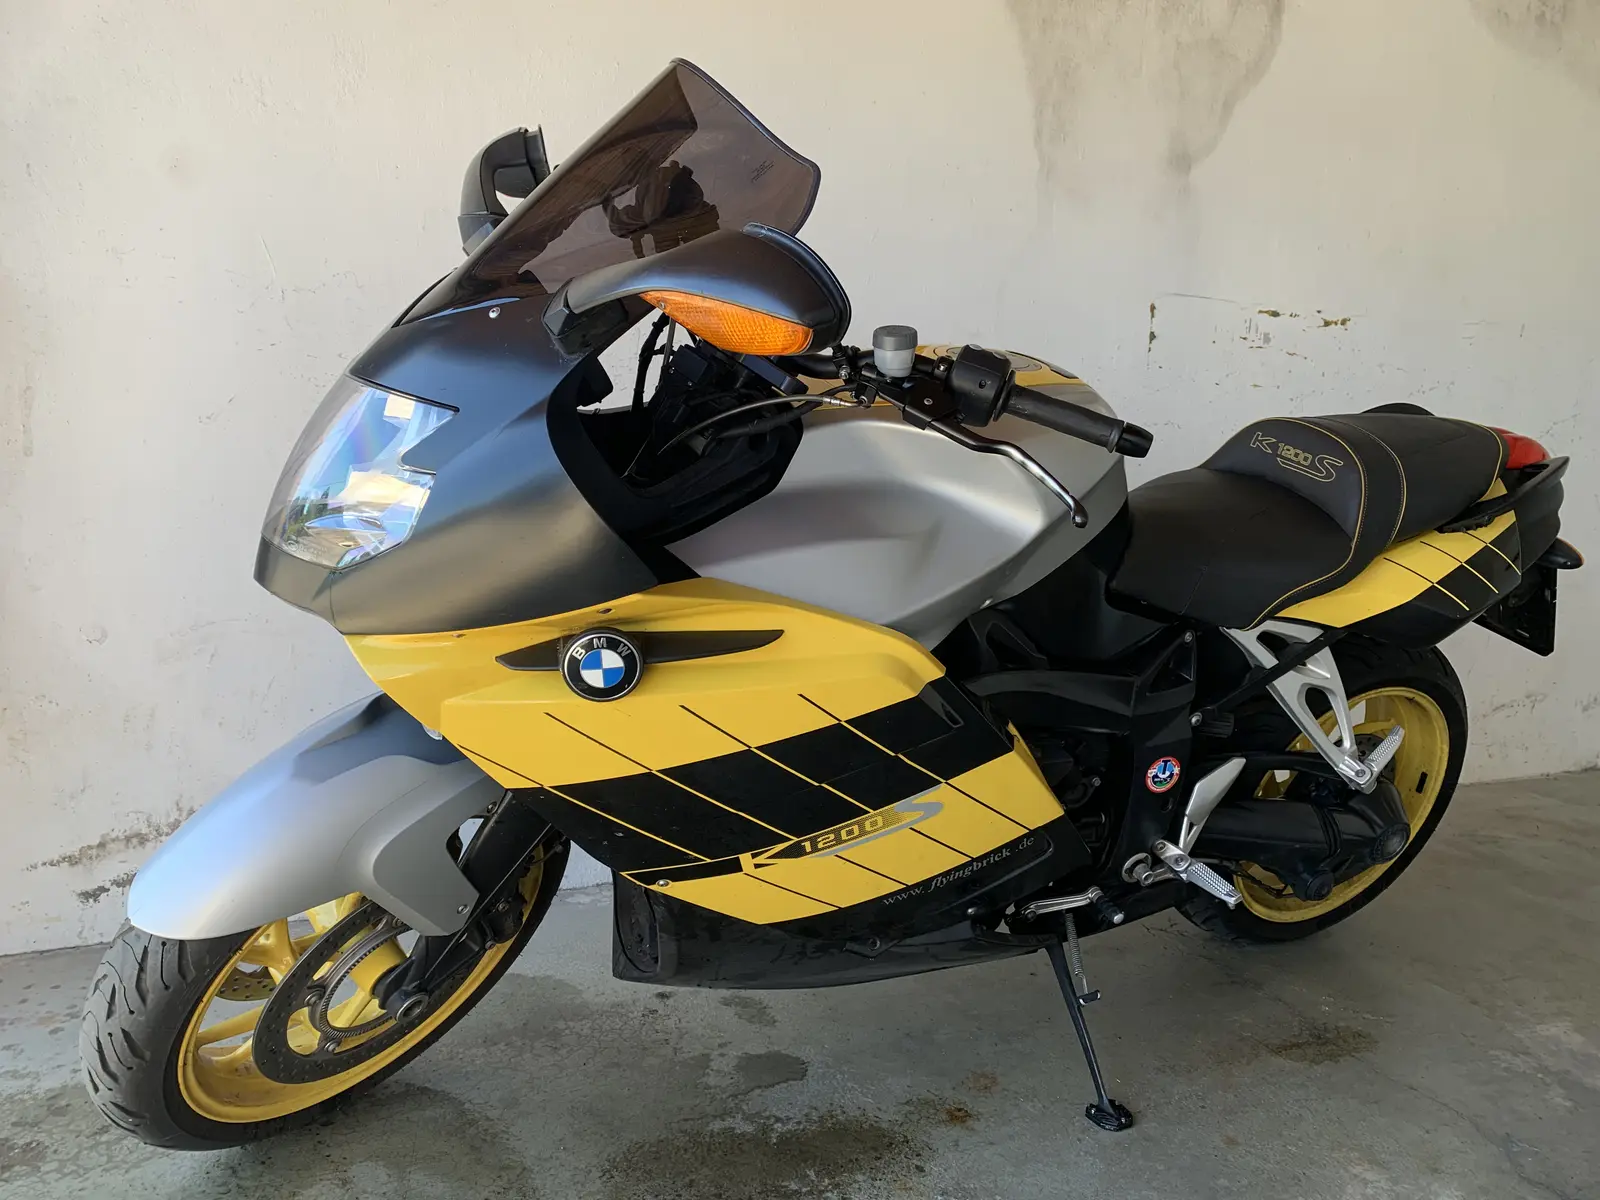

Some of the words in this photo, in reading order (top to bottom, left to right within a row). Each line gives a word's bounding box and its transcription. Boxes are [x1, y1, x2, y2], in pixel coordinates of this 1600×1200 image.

[1249, 431, 1277, 454] K
[1277, 442, 1313, 467] 1200
[572, 637, 632, 661] BMW
[801, 815, 884, 853] 1200
[928, 846, 1012, 893] flyingbrick
